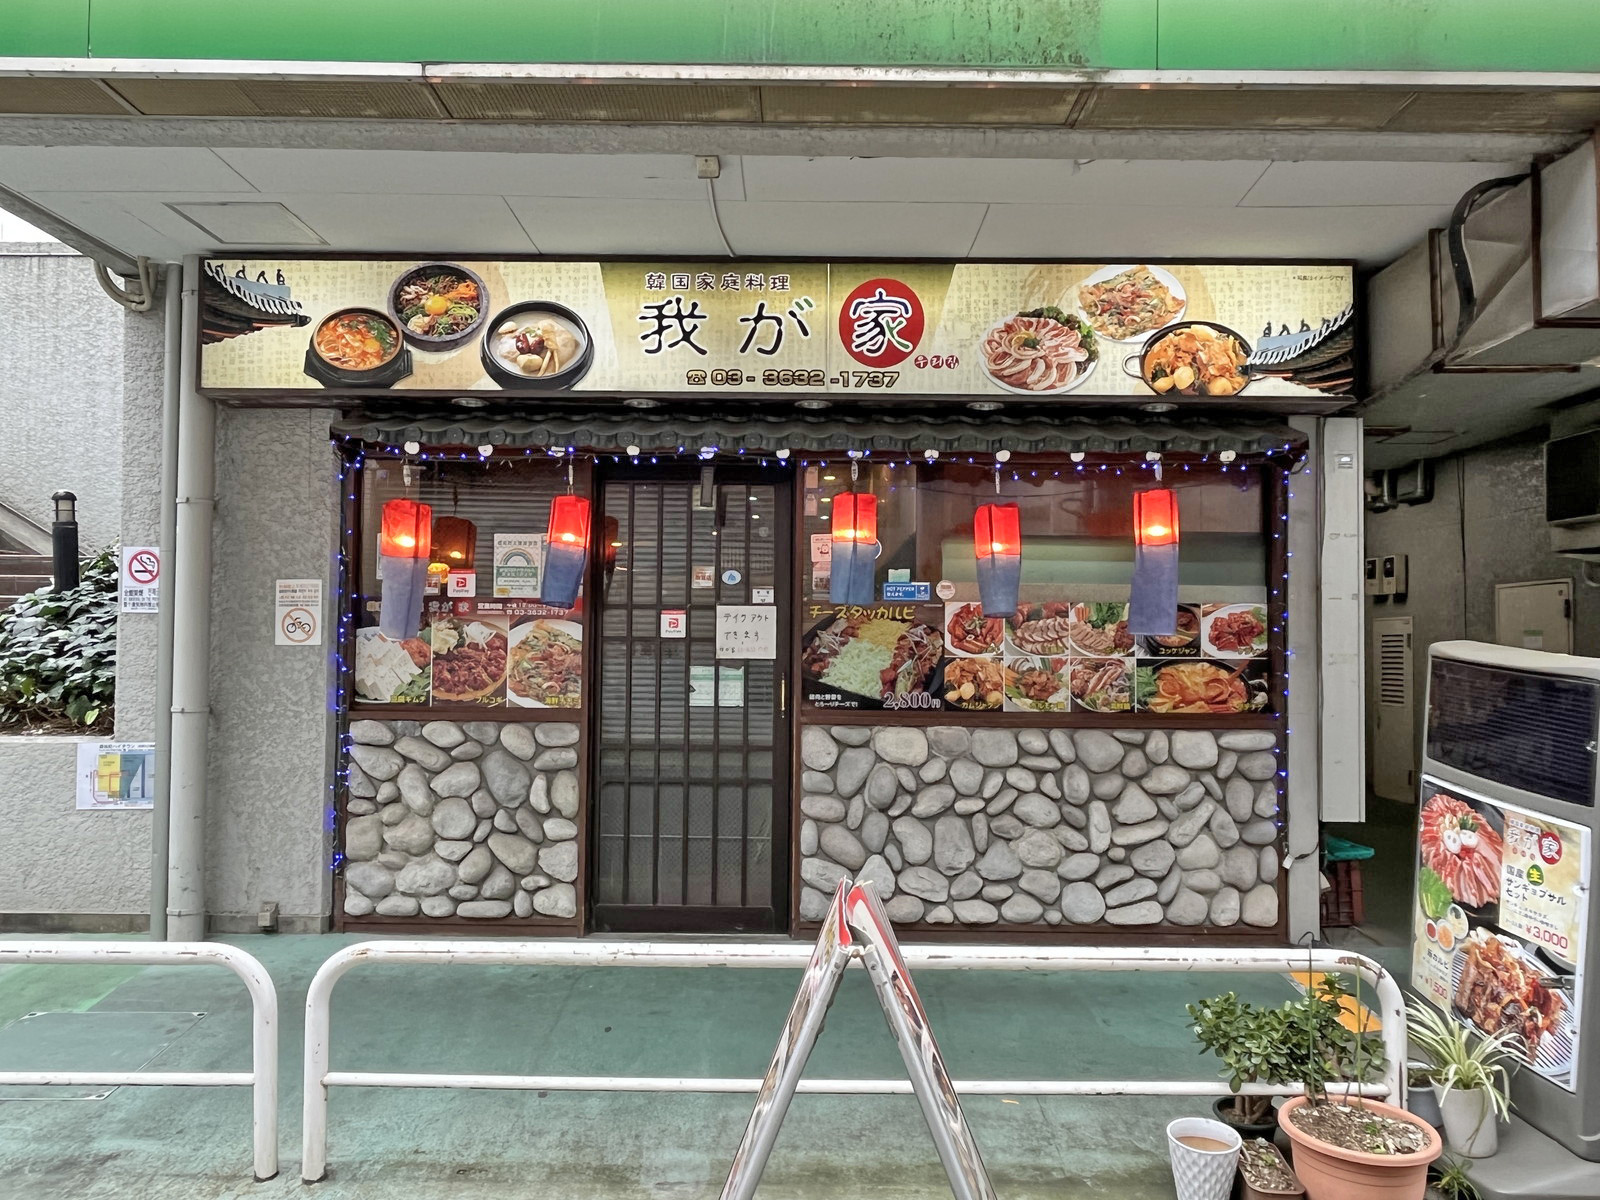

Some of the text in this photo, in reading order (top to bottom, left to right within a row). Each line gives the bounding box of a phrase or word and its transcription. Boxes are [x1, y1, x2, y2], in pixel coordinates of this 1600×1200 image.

[645, 272, 791, 291] 韓国家庭料理
[638, 287, 913, 356] 我が家
[914, 355, 959, 369] 우리집
[809, 605, 916, 620] チーズタッカルビ
[1529, 868, 1543, 883] 生
[1506, 887, 1528, 902] セット
